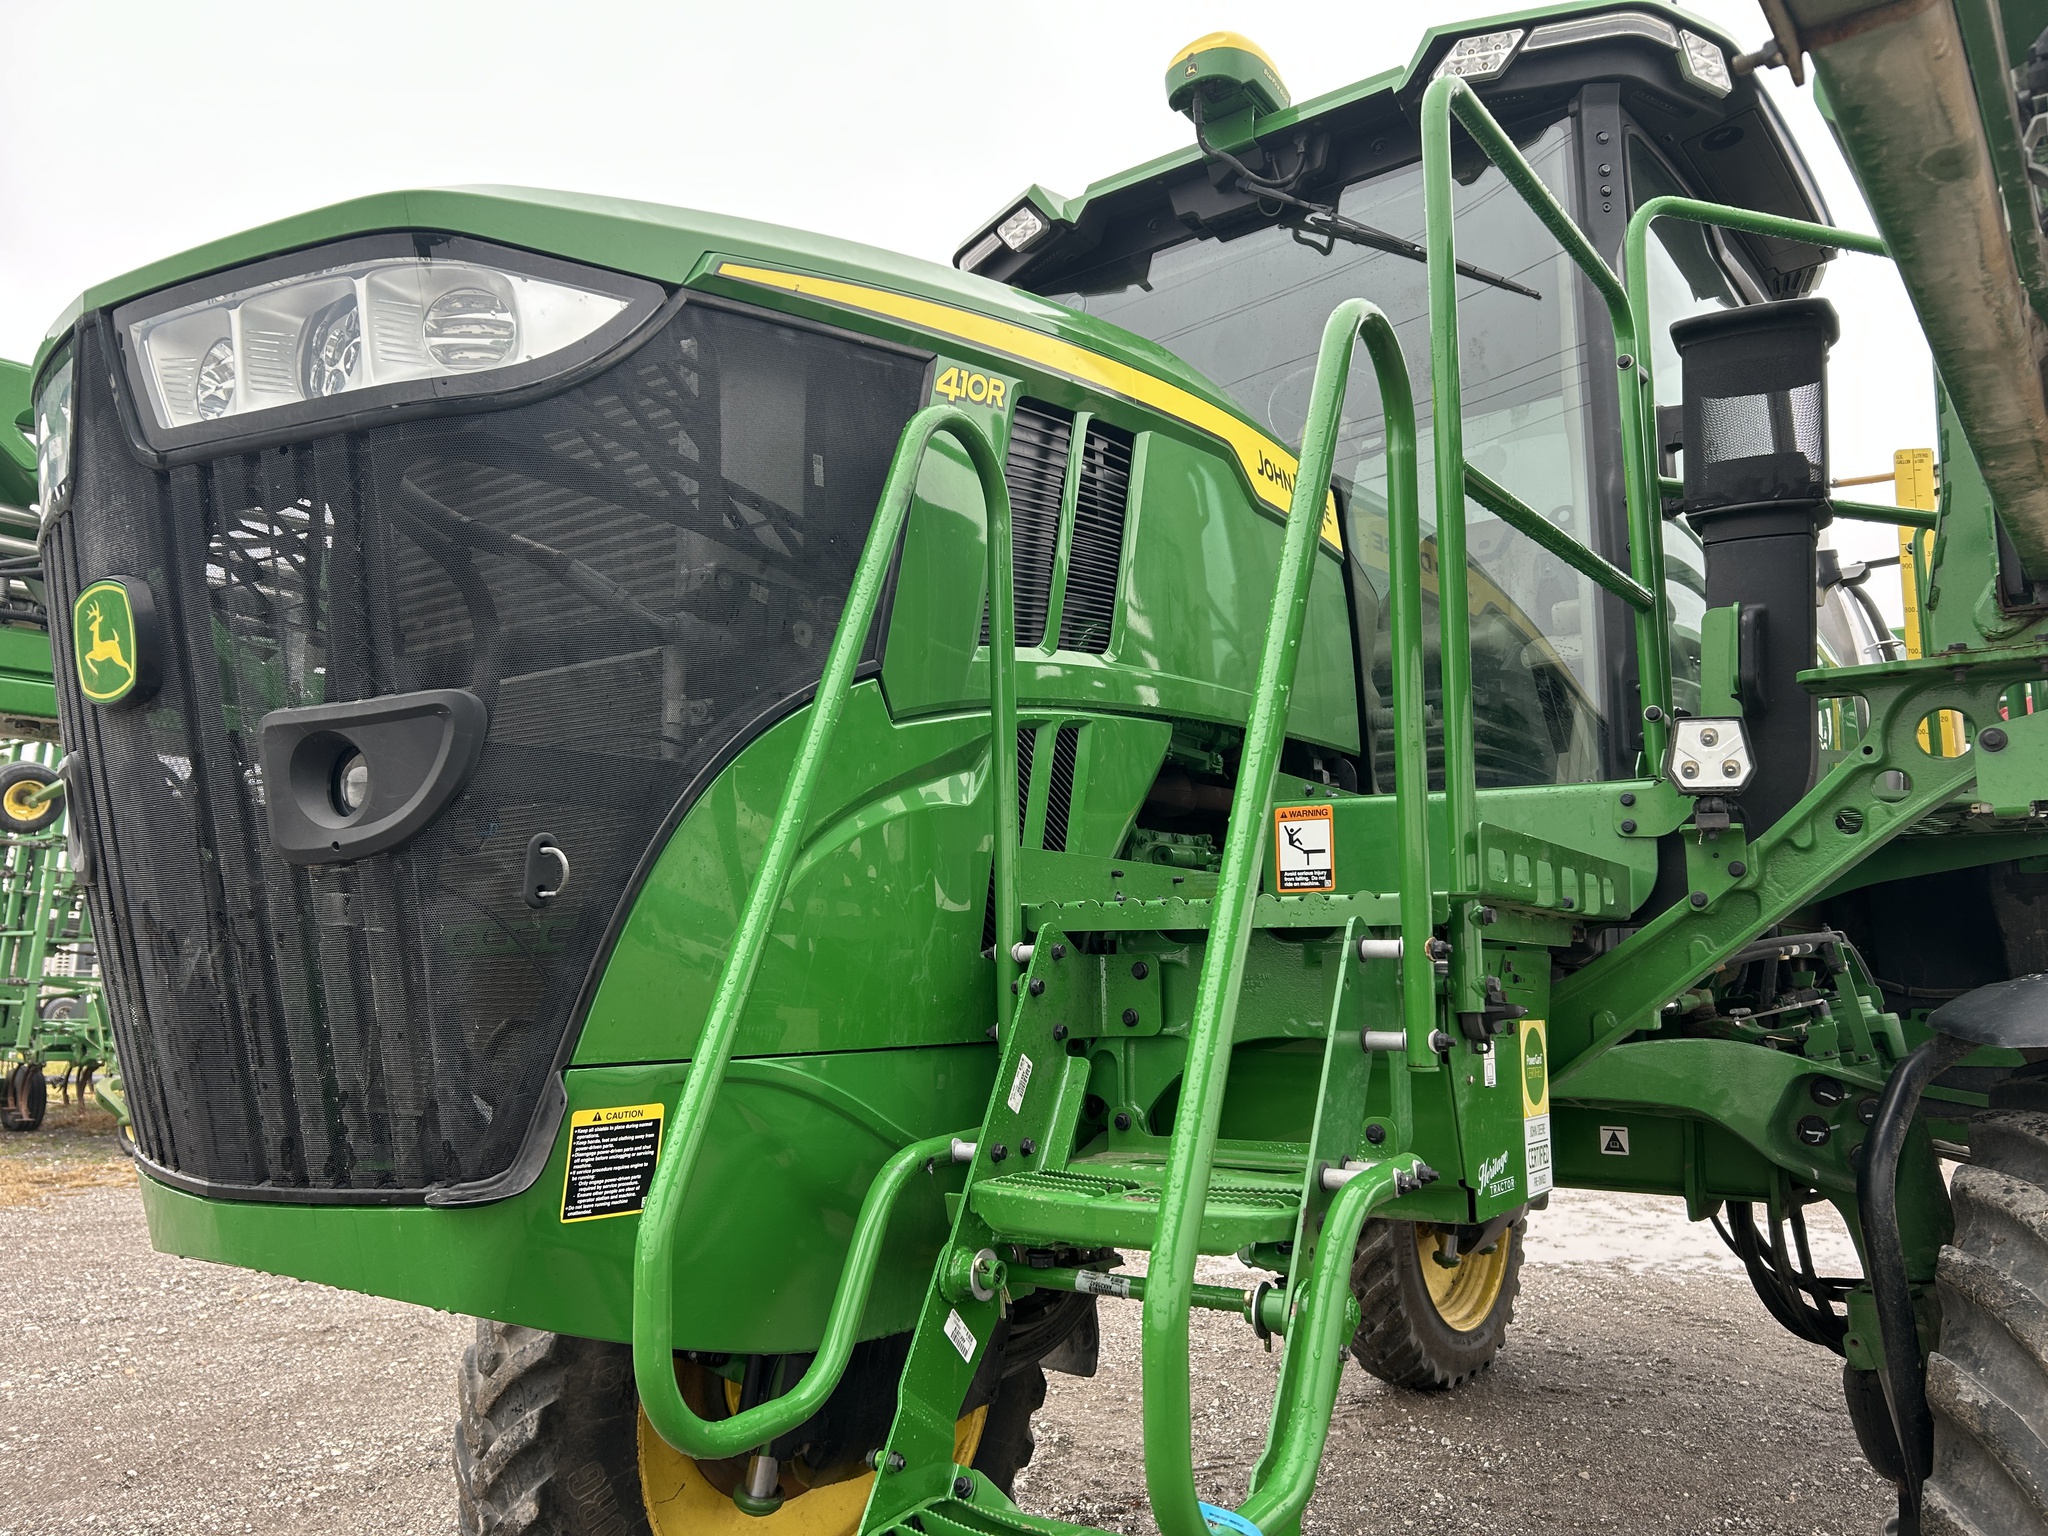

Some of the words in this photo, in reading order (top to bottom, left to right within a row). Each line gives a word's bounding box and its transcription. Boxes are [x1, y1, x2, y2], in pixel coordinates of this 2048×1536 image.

[935, 366, 1006, 410] 410R
[1257, 449, 1293, 495] JOHN
[1289, 808, 1328, 818] WARNING
[606, 1110, 644, 1120] CAUTION
[1478, 1150, 1509, 1196] Heritage
[1490, 1178, 1515, 1195] TRACTOR
